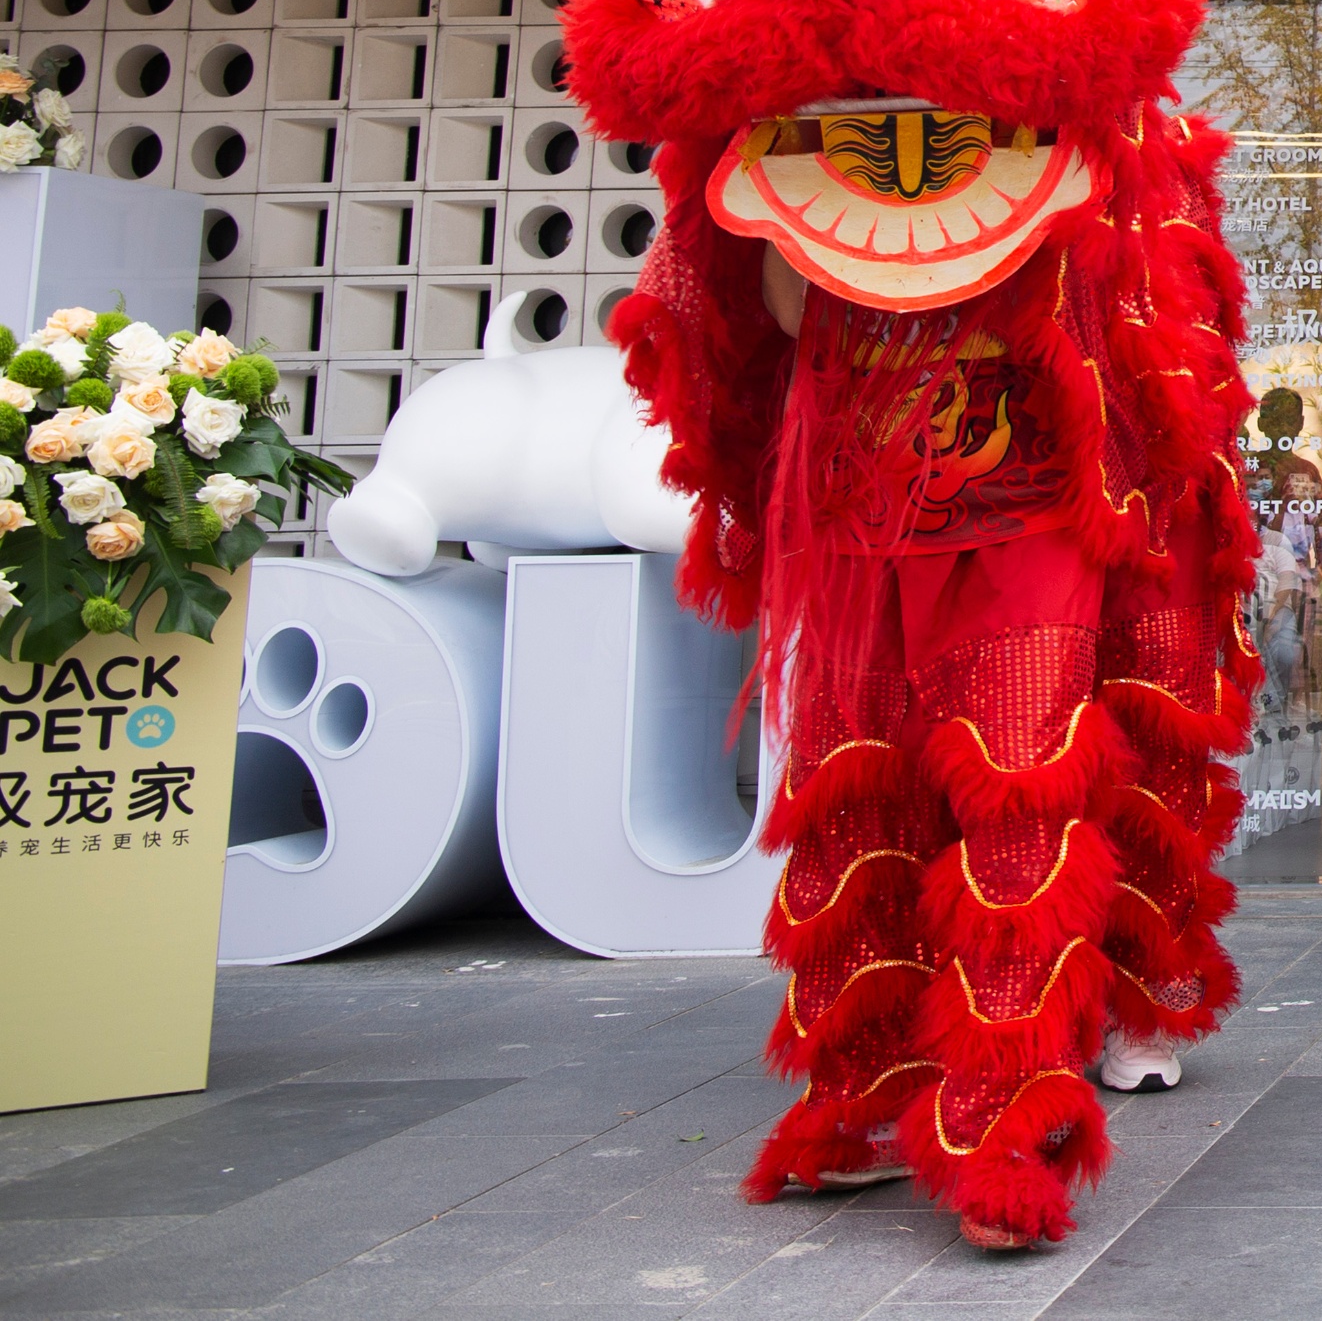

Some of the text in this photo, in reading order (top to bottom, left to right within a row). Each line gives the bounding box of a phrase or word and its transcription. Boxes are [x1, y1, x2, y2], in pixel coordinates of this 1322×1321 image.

[1248, 196, 1312, 212] HOTEL
[1273, 260, 1286, 273] &
[1278, 436, 1304, 451] OF
[0, 655, 181, 704] JACK
